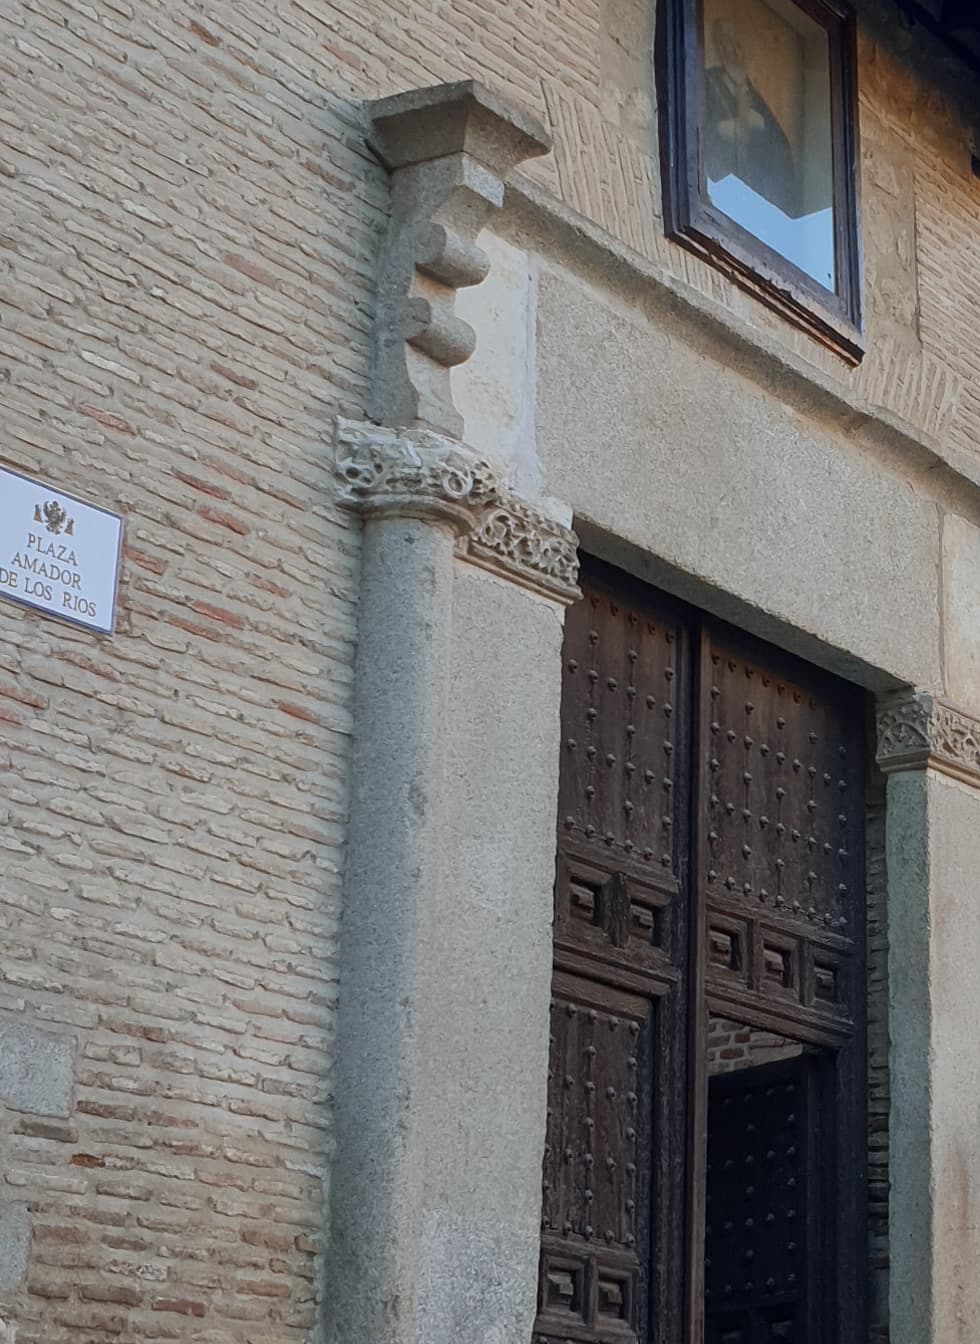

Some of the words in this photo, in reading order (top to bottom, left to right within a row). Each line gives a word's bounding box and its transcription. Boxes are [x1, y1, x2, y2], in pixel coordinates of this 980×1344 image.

[27, 533, 79, 566] PLAZA
[11, 552, 81, 590] AMADOR
[0, 567, 18, 588] DE
[24, 577, 53, 601] LOS
[62, 592, 97, 617] RIOS
